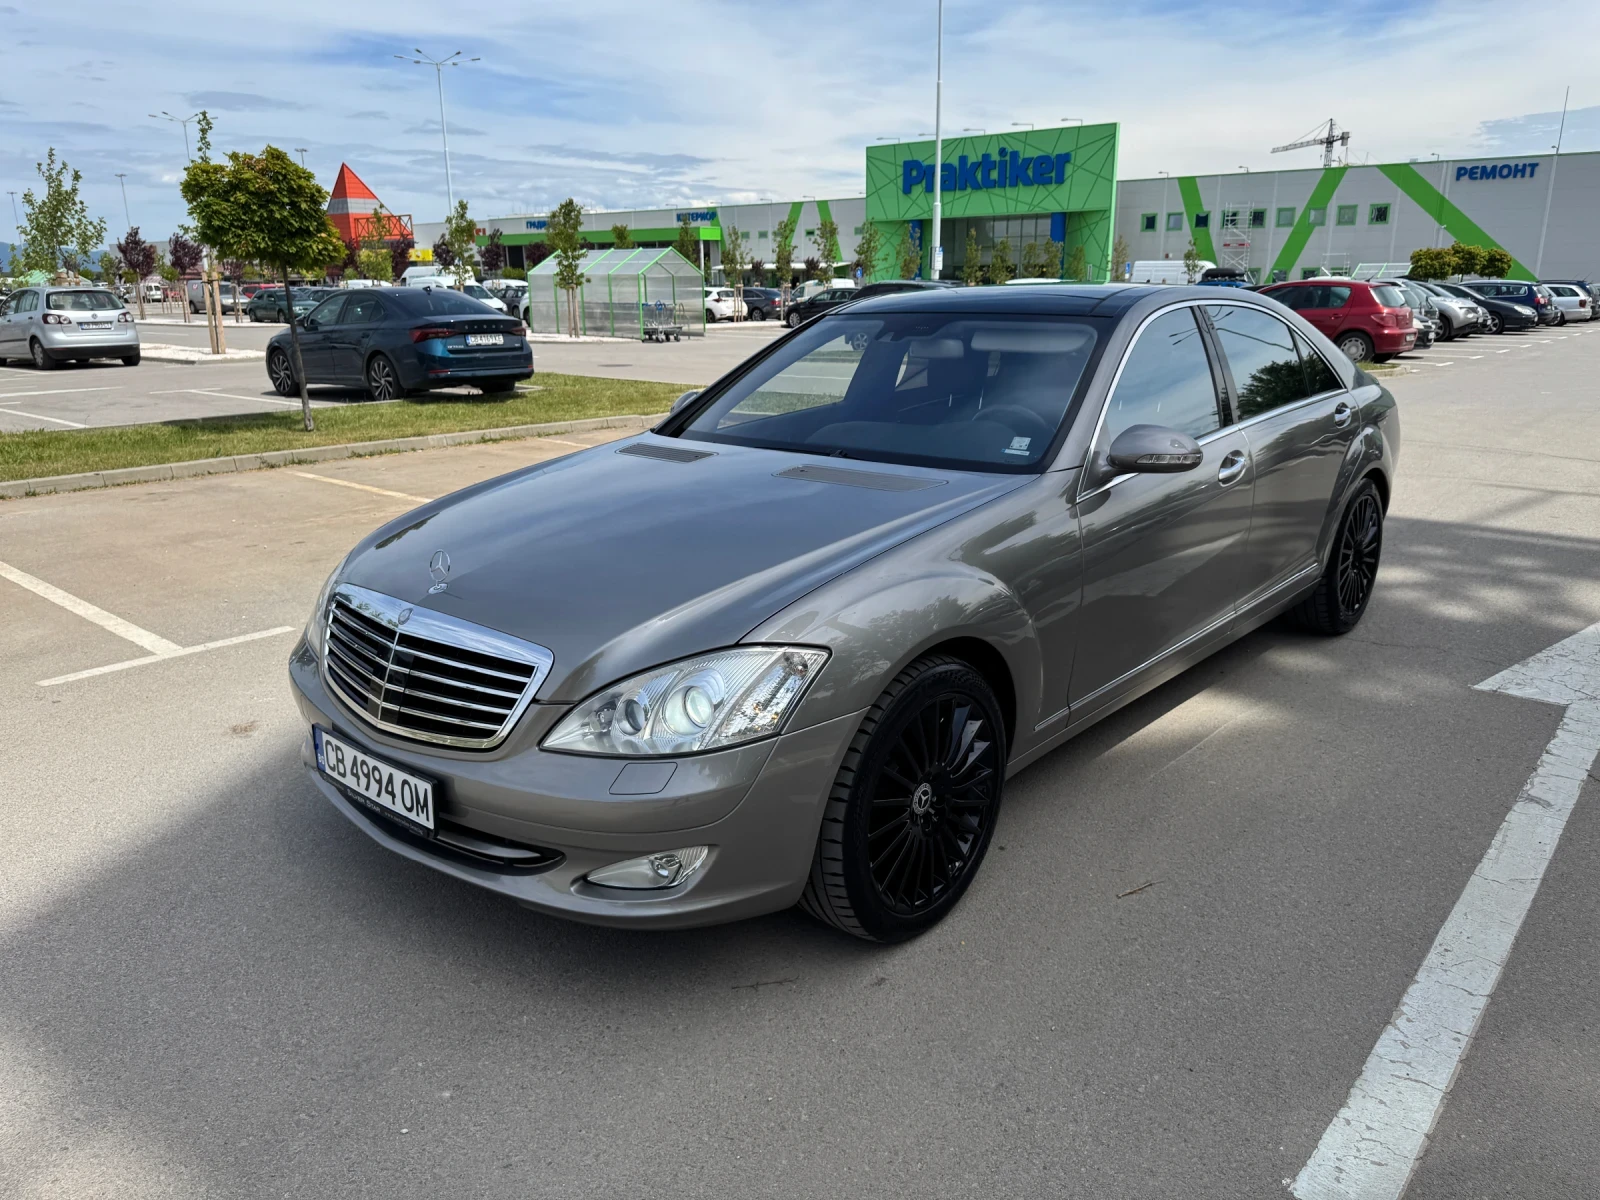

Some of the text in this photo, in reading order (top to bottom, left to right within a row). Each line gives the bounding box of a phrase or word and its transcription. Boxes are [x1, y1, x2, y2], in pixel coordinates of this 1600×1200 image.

[902, 147, 1072, 194] Praktiker
[1455, 162, 1539, 181] РЕМОНТ
[324, 739, 430, 822] CB 4994 OM
